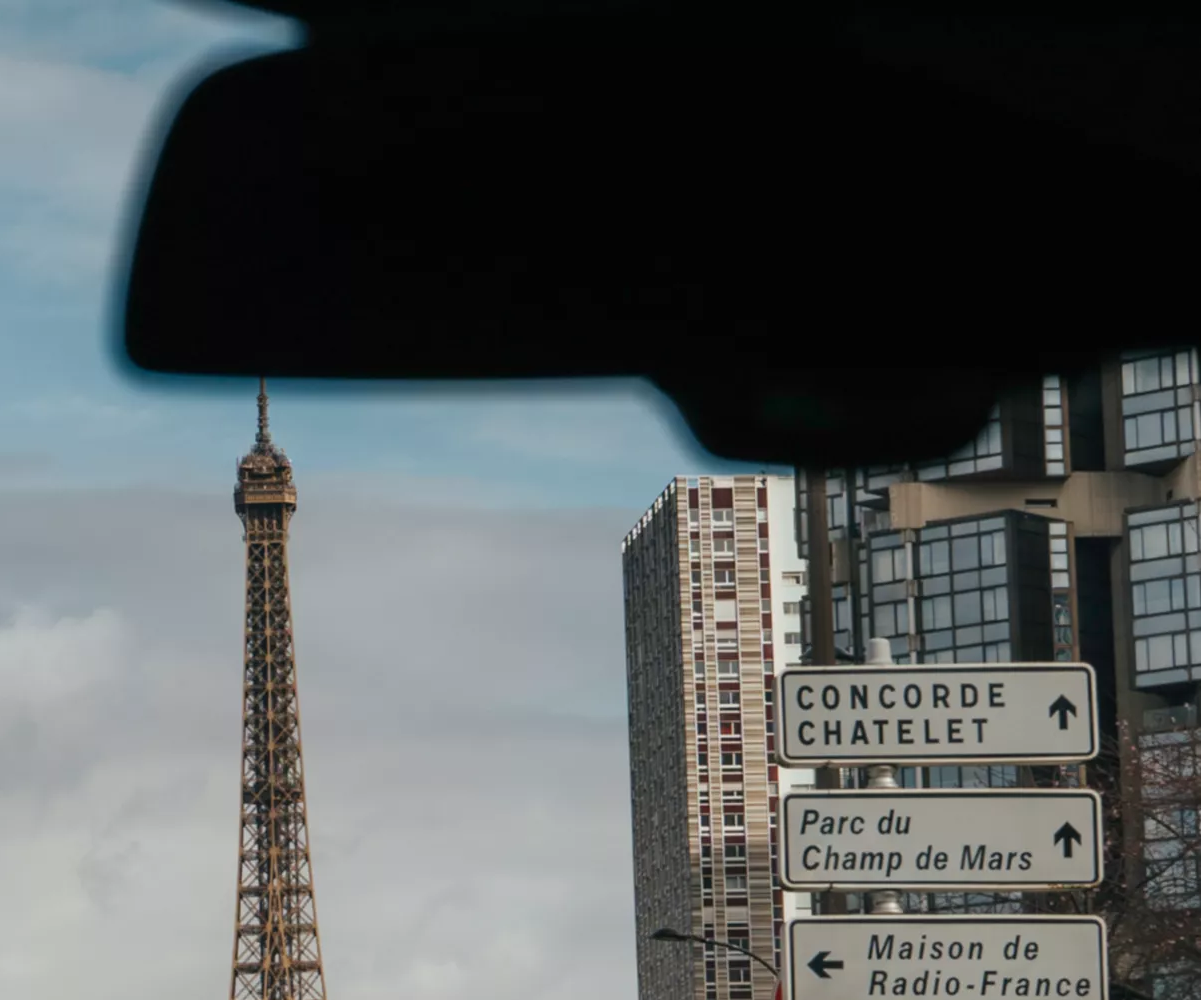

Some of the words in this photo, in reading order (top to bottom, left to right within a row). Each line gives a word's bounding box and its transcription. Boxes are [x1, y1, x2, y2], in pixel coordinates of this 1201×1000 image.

[797, 682, 1006, 711] CONCORDE
[798, 717, 988, 746] CHATELET
[800, 809, 865, 835] Parc
[878, 809, 911, 835] du
[802, 845, 903, 877] Champ
[915, 845, 948, 871] de
[960, 845, 1033, 871] Mars
[867, 934, 984, 961] Maison
[1003, 934, 1039, 961] de
[868, 969, 1091, 997] Radio-France
